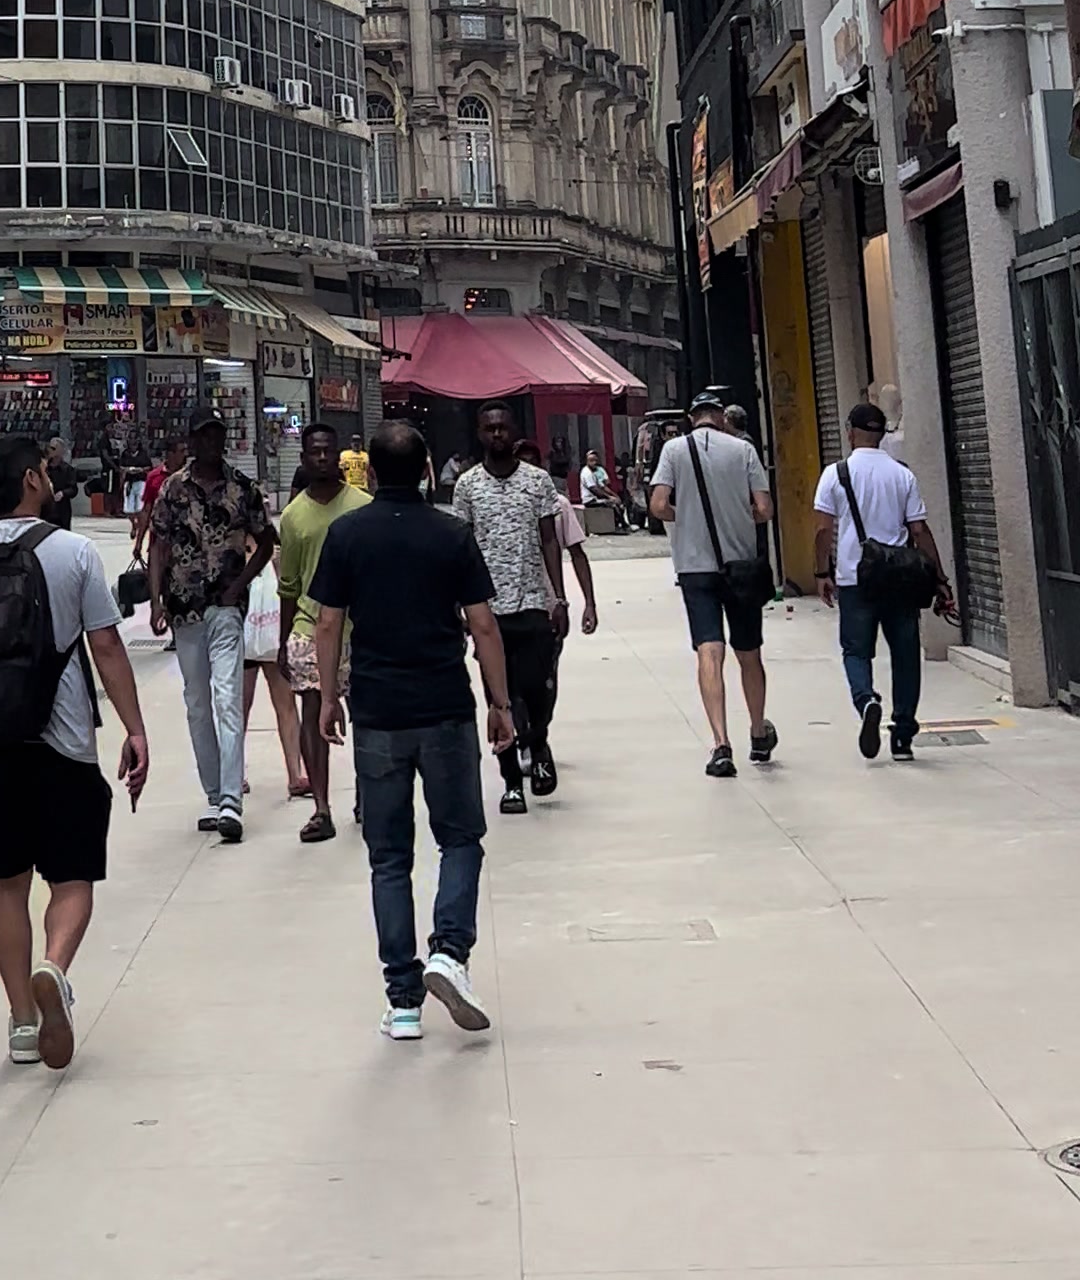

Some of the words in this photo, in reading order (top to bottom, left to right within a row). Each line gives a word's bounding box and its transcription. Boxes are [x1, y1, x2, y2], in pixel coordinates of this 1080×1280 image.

[85, 304, 134, 319] SMART
[0, 318, 53, 329] CELULAR
[7, 335, 21, 347] NA
[22, 334, 50, 346] HORA
